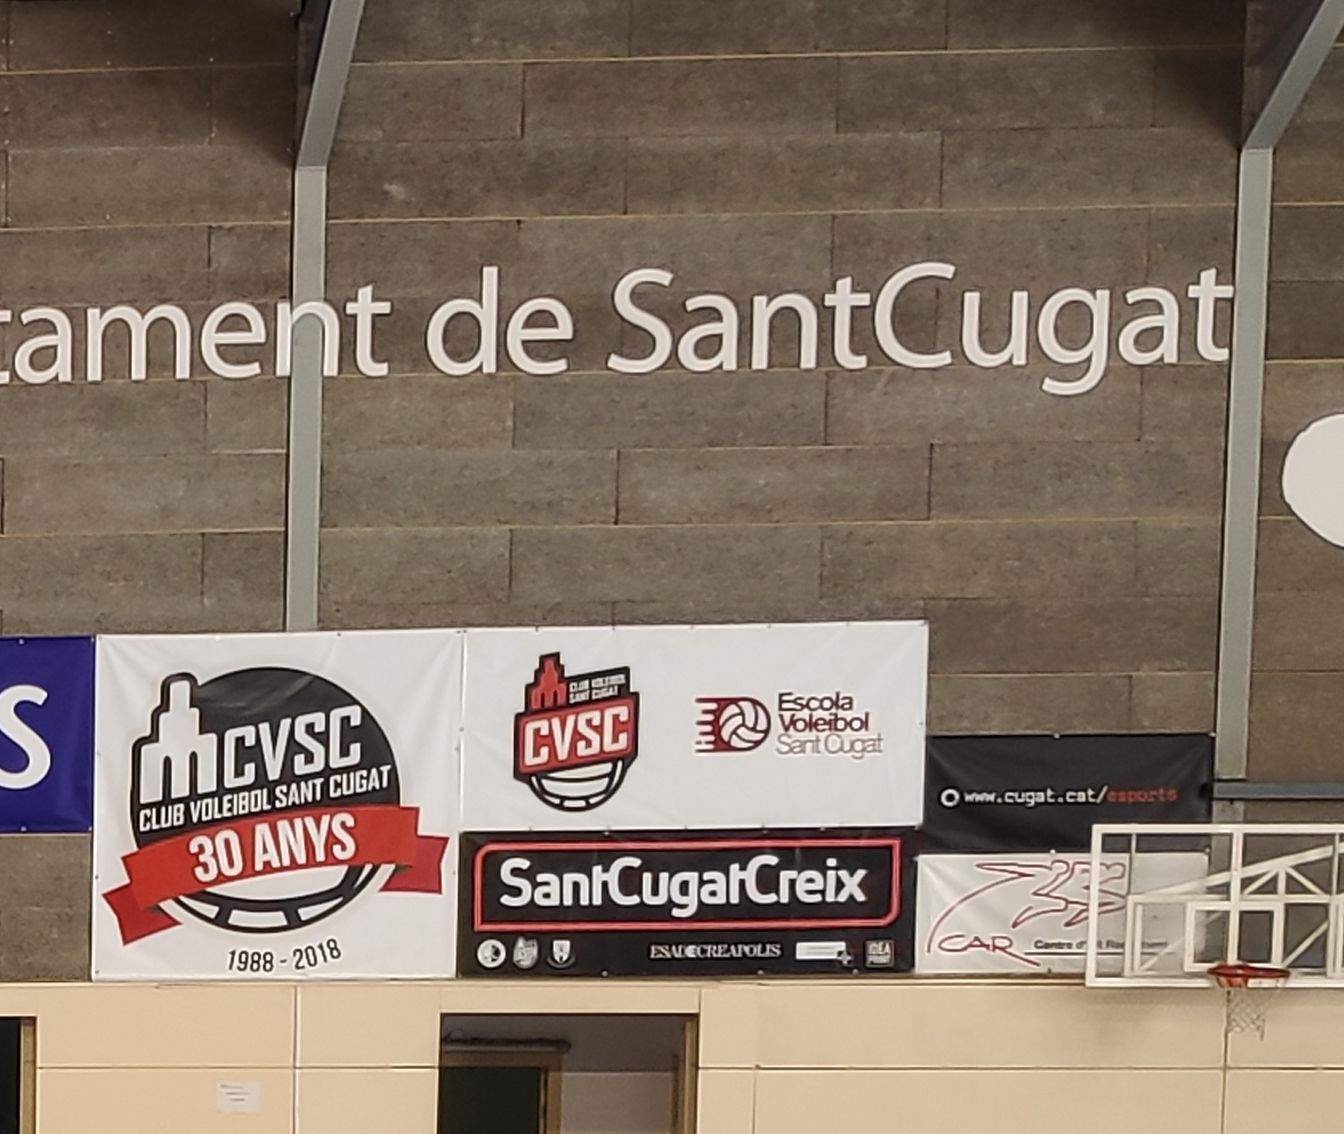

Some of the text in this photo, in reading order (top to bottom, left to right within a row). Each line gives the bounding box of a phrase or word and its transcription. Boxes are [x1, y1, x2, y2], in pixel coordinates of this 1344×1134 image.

[427, 267, 573, 375] de
[605, 262, 1235, 396] SantCugat
[777, 691, 854, 712] Escola
[778, 712, 870, 733] Voleibol
[223, 704, 363, 789] CVSC
[524, 705, 629, 766] CVSC
[776, 735, 820, 754] Sant
[138, 764, 392, 832] CLUB VOLEIBOL SANT CUGAT
[188, 811, 356, 883] 30 ANYS
[499, 857, 867, 918] SantCugatCreix
[226, 948, 275, 973] 1988
[292, 938, 343, 971] 2018
